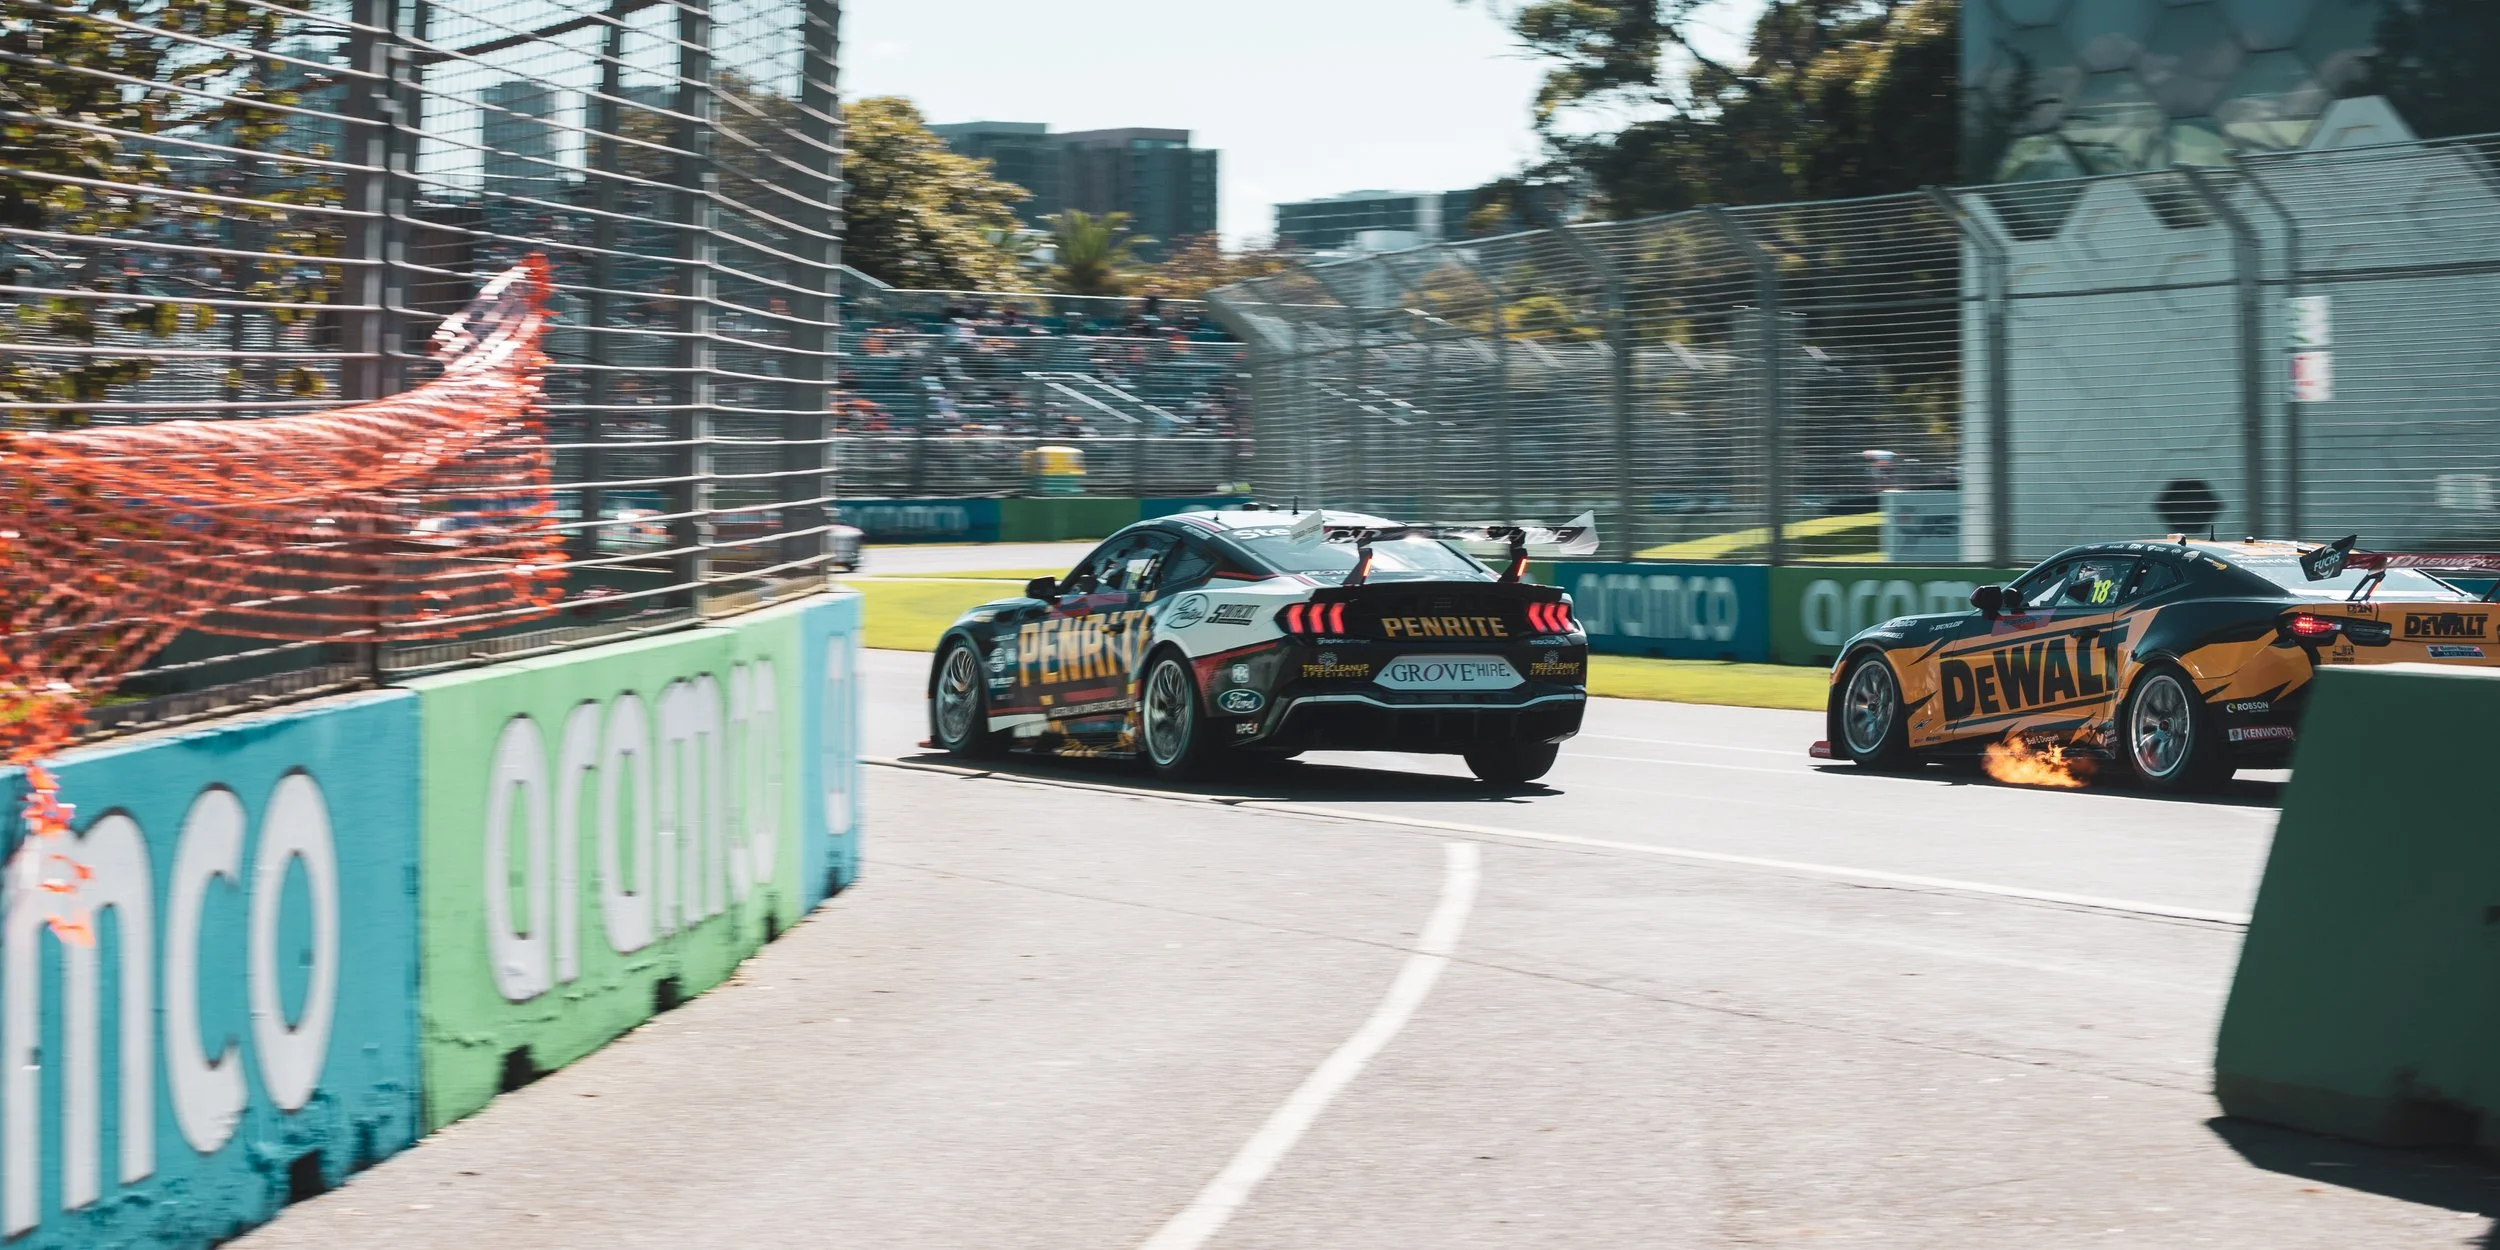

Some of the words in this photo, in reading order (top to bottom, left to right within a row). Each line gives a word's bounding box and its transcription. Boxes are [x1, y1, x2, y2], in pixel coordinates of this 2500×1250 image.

[2314, 555, 2341, 571] FUCHS
[2091, 579, 2114, 604] 18
[1381, 616, 1509, 637] PENRITE
[1391, 664, 1475, 682] GROVE
[1477, 664, 1505, 676] HIRE
[2237, 702, 2269, 711] ROBSON
[2243, 727, 2294, 738] KENWORTH
[486, 656, 782, 1002] aramco
